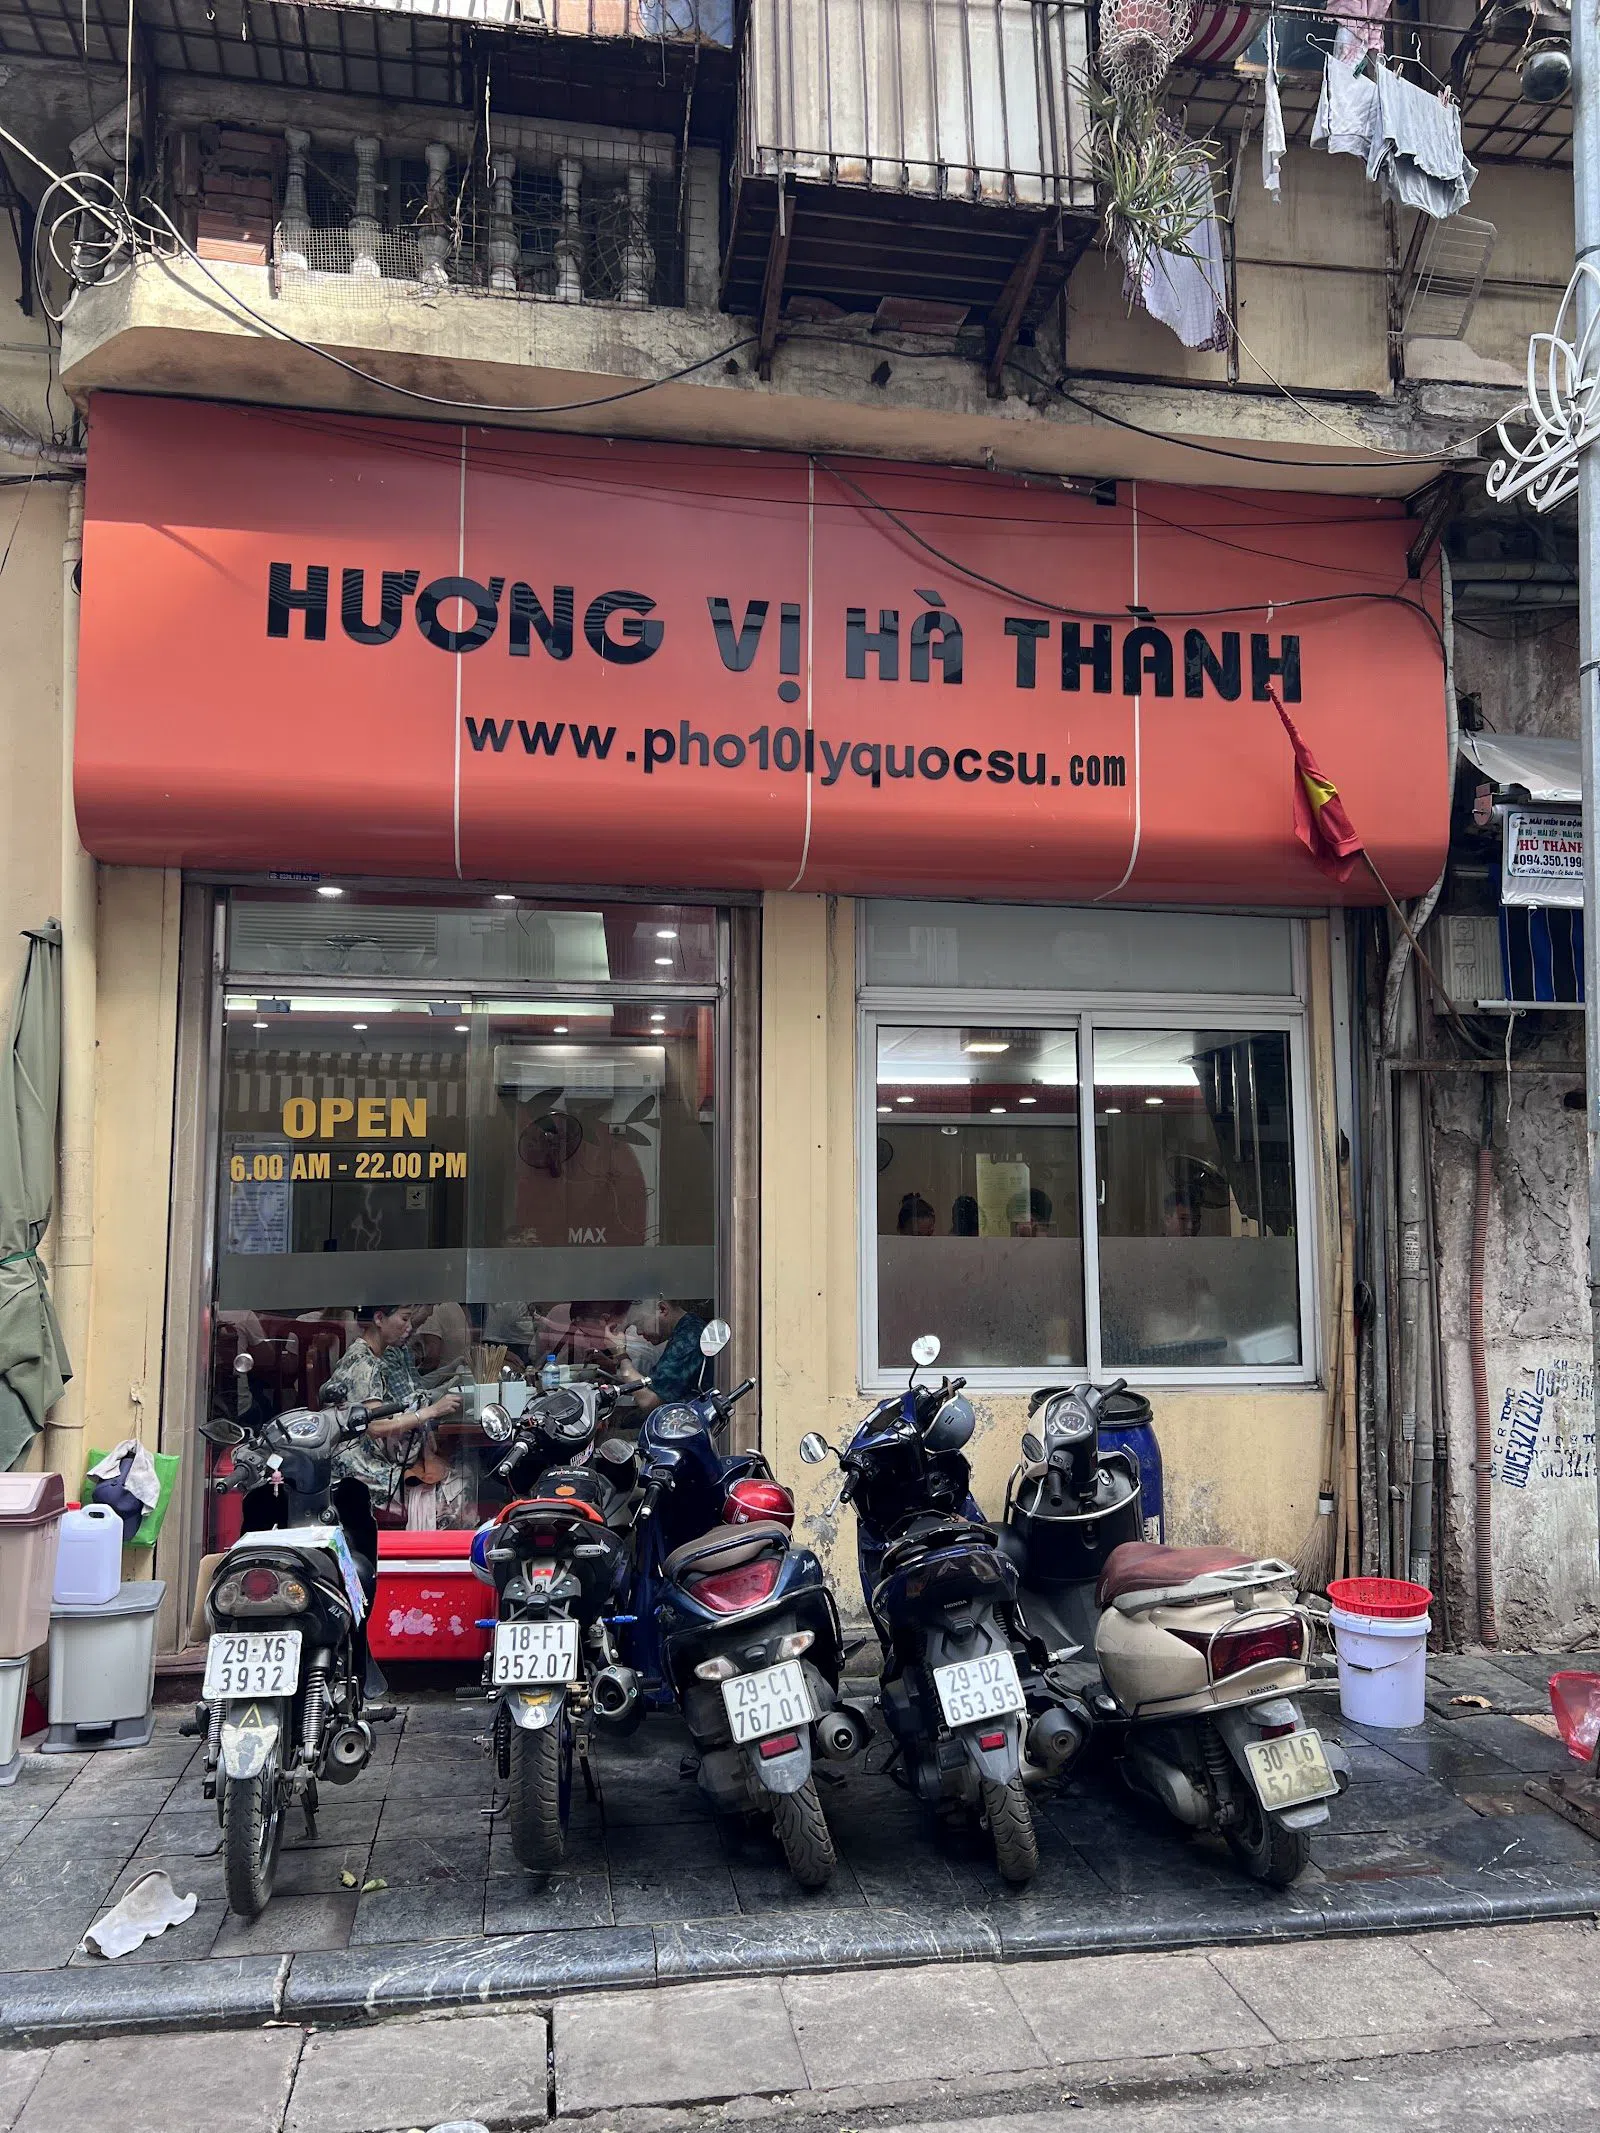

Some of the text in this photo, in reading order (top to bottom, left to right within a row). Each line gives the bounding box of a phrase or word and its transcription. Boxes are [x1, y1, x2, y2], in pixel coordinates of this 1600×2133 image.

[267, 562, 1302, 704] HƯƠNG VỊ HÀ THÀNH
[1517, 836, 1539, 850] HÚ
[1520, 854, 1583, 868] 094.350.199
[282, 1097, 427, 1139] OPEN
[230, 1154, 283, 1182] 6.00
[291, 1152, 330, 1180] AM
[355, 1152, 422, 1179] 22.00
[428, 1152, 467, 1178] PM
[568, 1226, 607, 1244] MAX
[223, 1638, 286, 1664] 29-X6
[510, 1625, 564, 1651] 18-F1
[219, 1666, 283, 1692] 3932
[498, 1653, 572, 1680] 352.07
[946, 1659, 1004, 1693] 29-D2
[735, 1668, 791, 1707] 29-C1
[735, 1694, 805, 1738] 767.01
[948, 1683, 1018, 1721] 653.95
